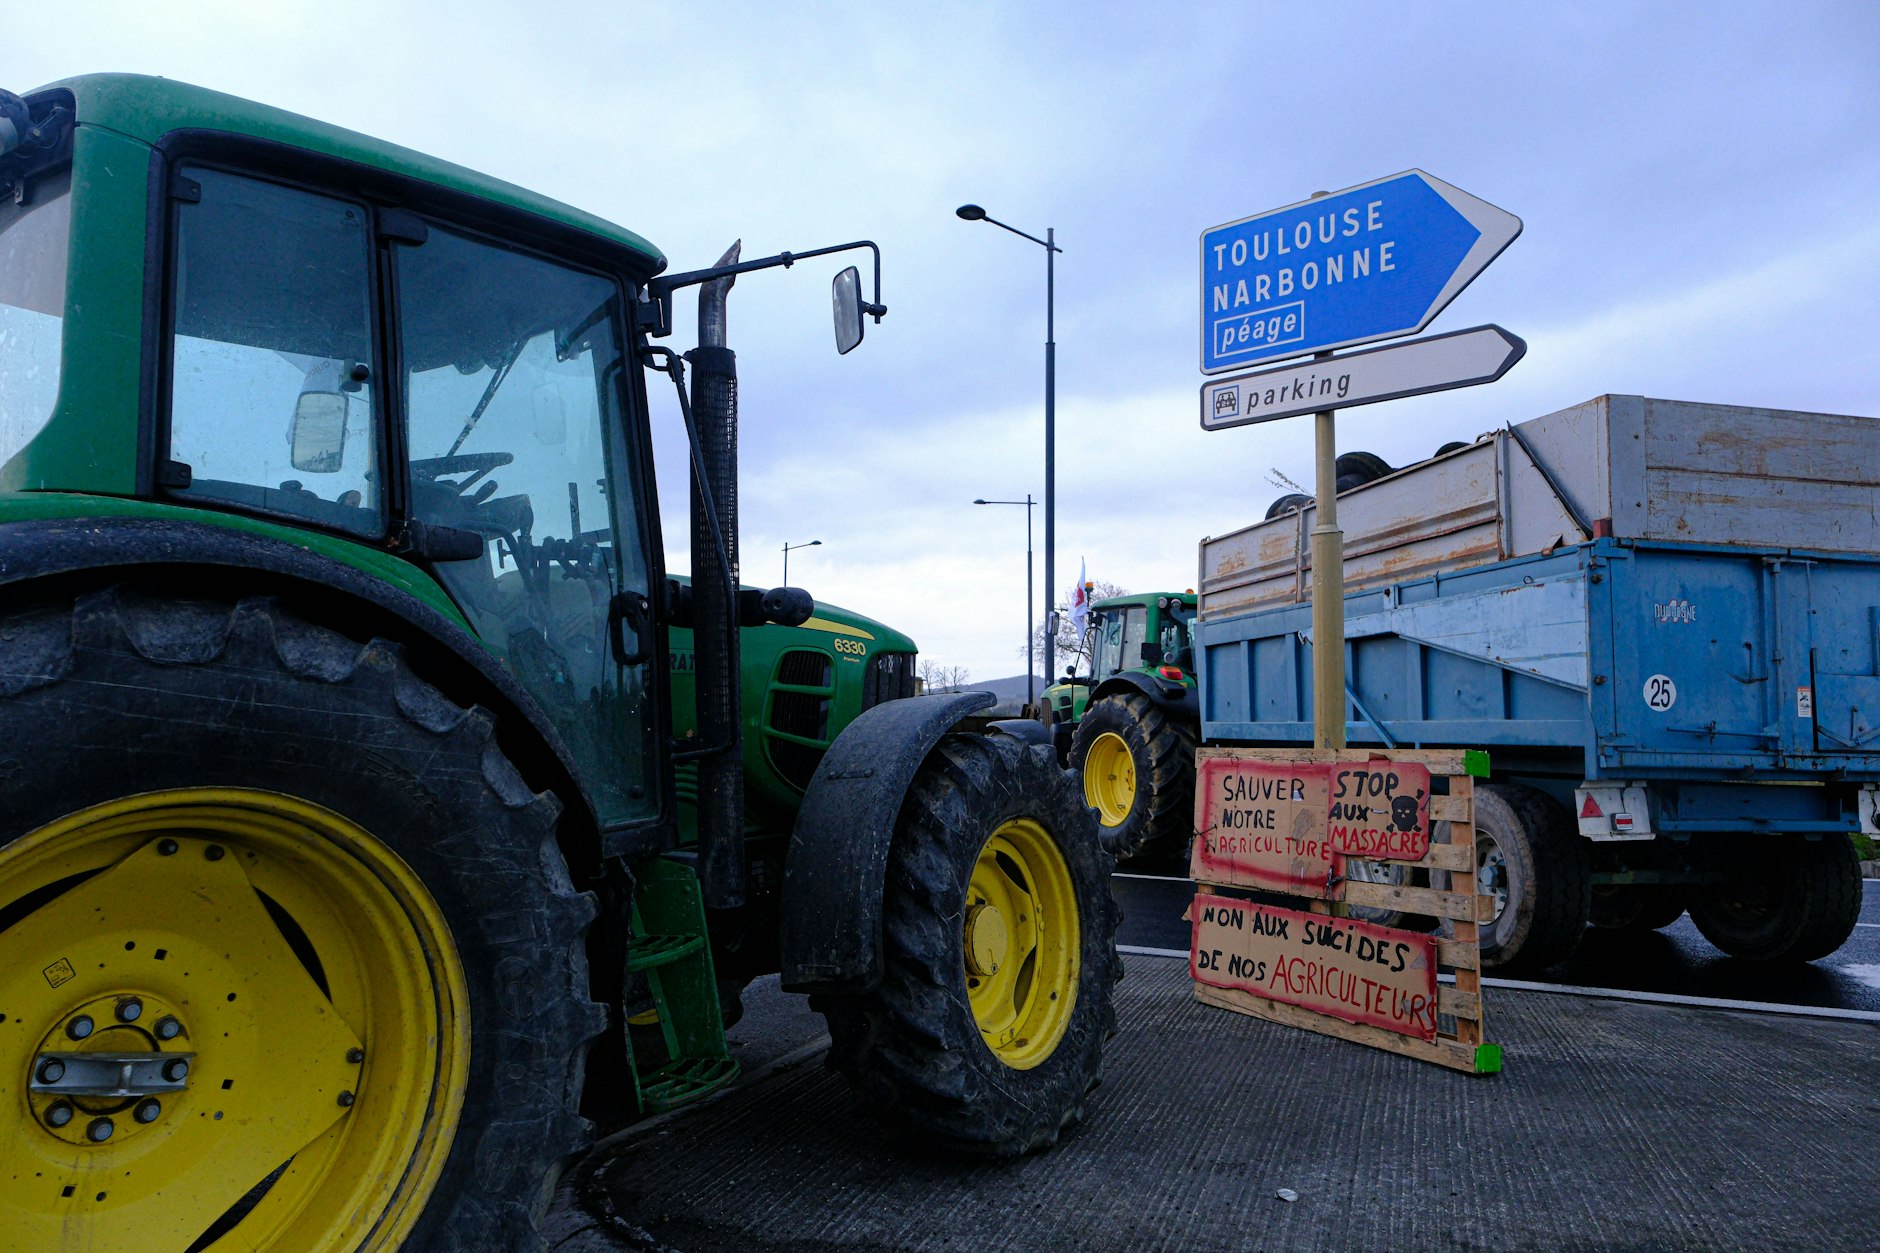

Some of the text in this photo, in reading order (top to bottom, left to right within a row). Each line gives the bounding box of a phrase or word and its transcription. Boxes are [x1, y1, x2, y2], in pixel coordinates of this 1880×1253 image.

[1213, 200, 1383, 271] TOULOUSE
[1213, 241, 1396, 313] NARBONNE
[1221, 312, 1297, 353] péage
[1246, 373, 1351, 414] parking
[834, 638, 867, 656] 6330
[1650, 678, 1671, 708] 25
[1222, 775, 1305, 801] SAUVER
[1333, 770, 1399, 798] STOP
[1222, 808, 1276, 829] NOTRE
[1328, 801, 1370, 822] AUX
[1203, 907, 1244, 930] NON
[1252, 911, 1290, 940] AUX
[1198, 950, 1223, 971] DE
[1228, 953, 1267, 981] NOS
